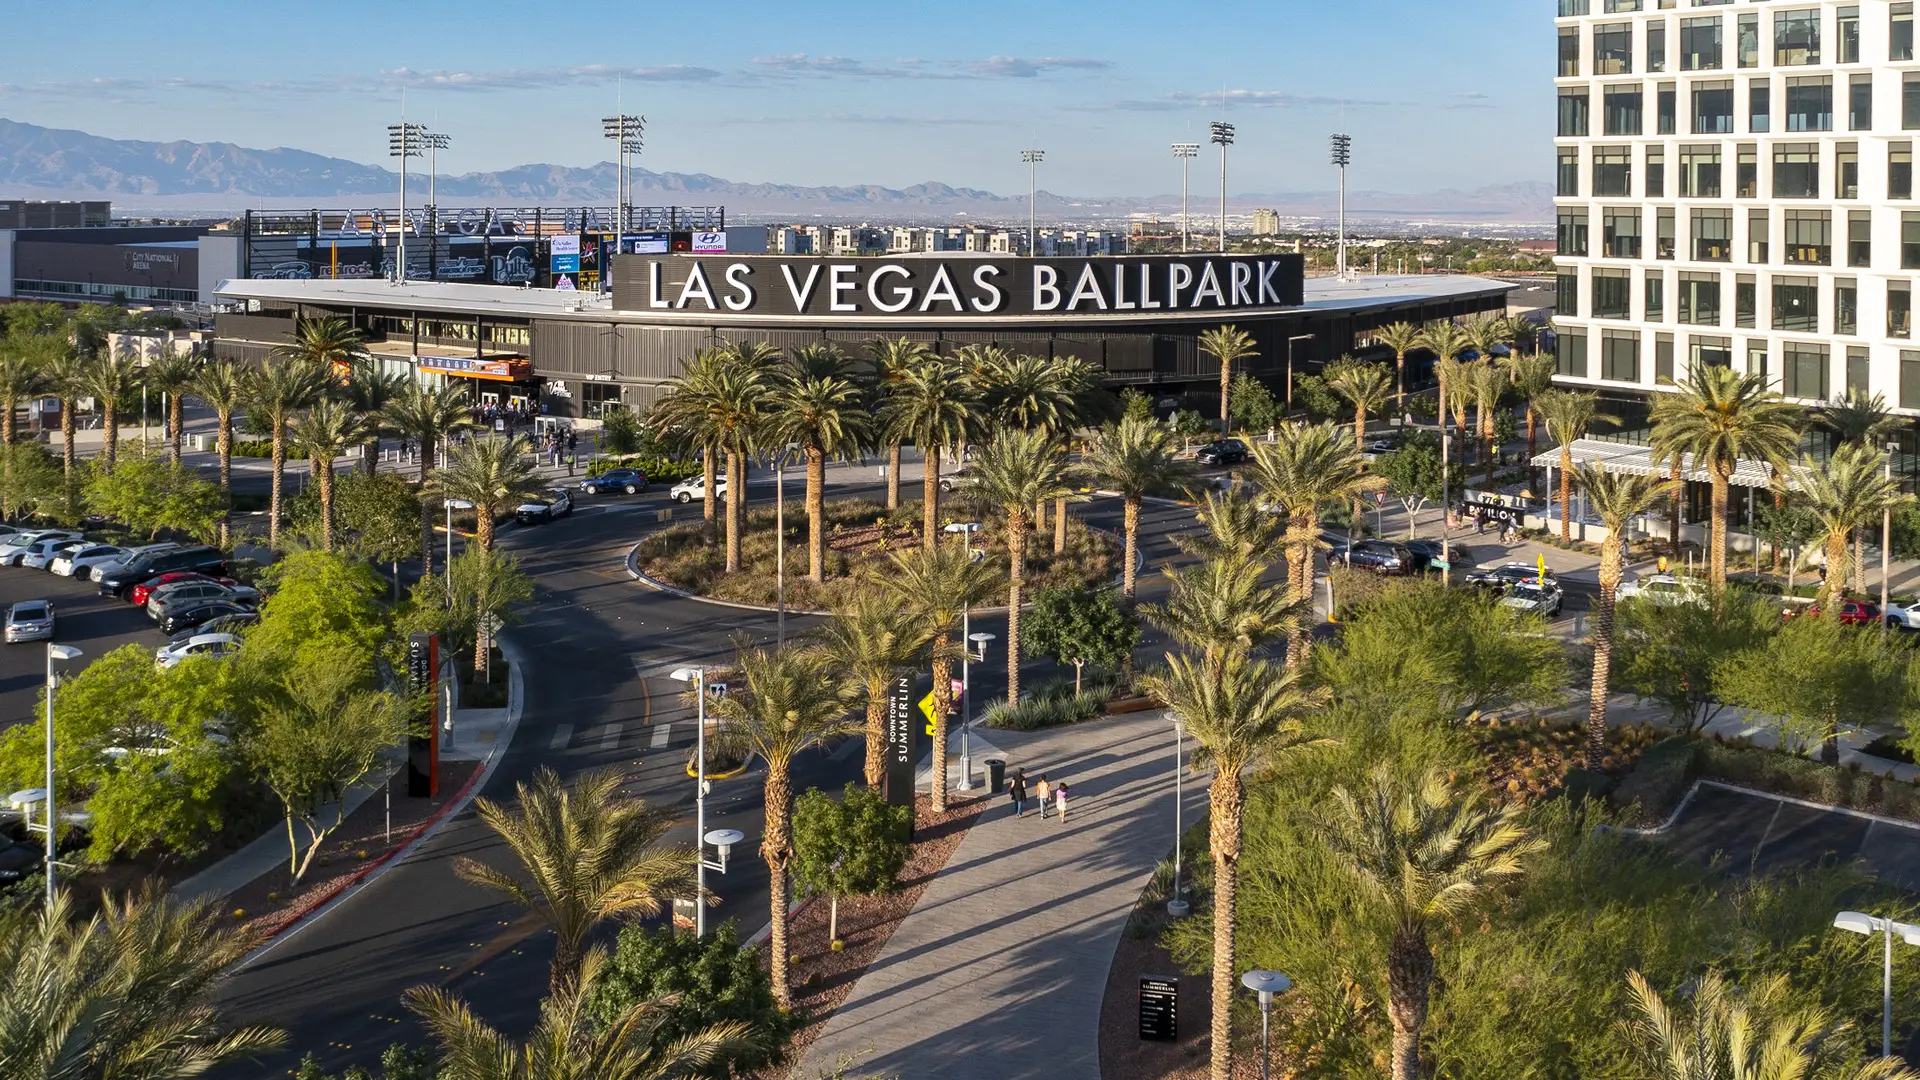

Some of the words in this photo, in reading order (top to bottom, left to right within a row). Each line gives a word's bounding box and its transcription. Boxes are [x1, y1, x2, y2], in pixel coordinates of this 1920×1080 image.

[317, 208, 387, 238] LAS
[407, 207, 527, 237] VEGAS
[133, 262, 150, 270] ARENA
[649, 260, 752, 311] LAS
[780, 263, 1000, 313] VEGAS
[1033, 260, 1280, 311] BALLPARK
[899, 678, 908, 762] SUMMERLIN
[1142, 984, 1175, 992] SUMMERLIN
